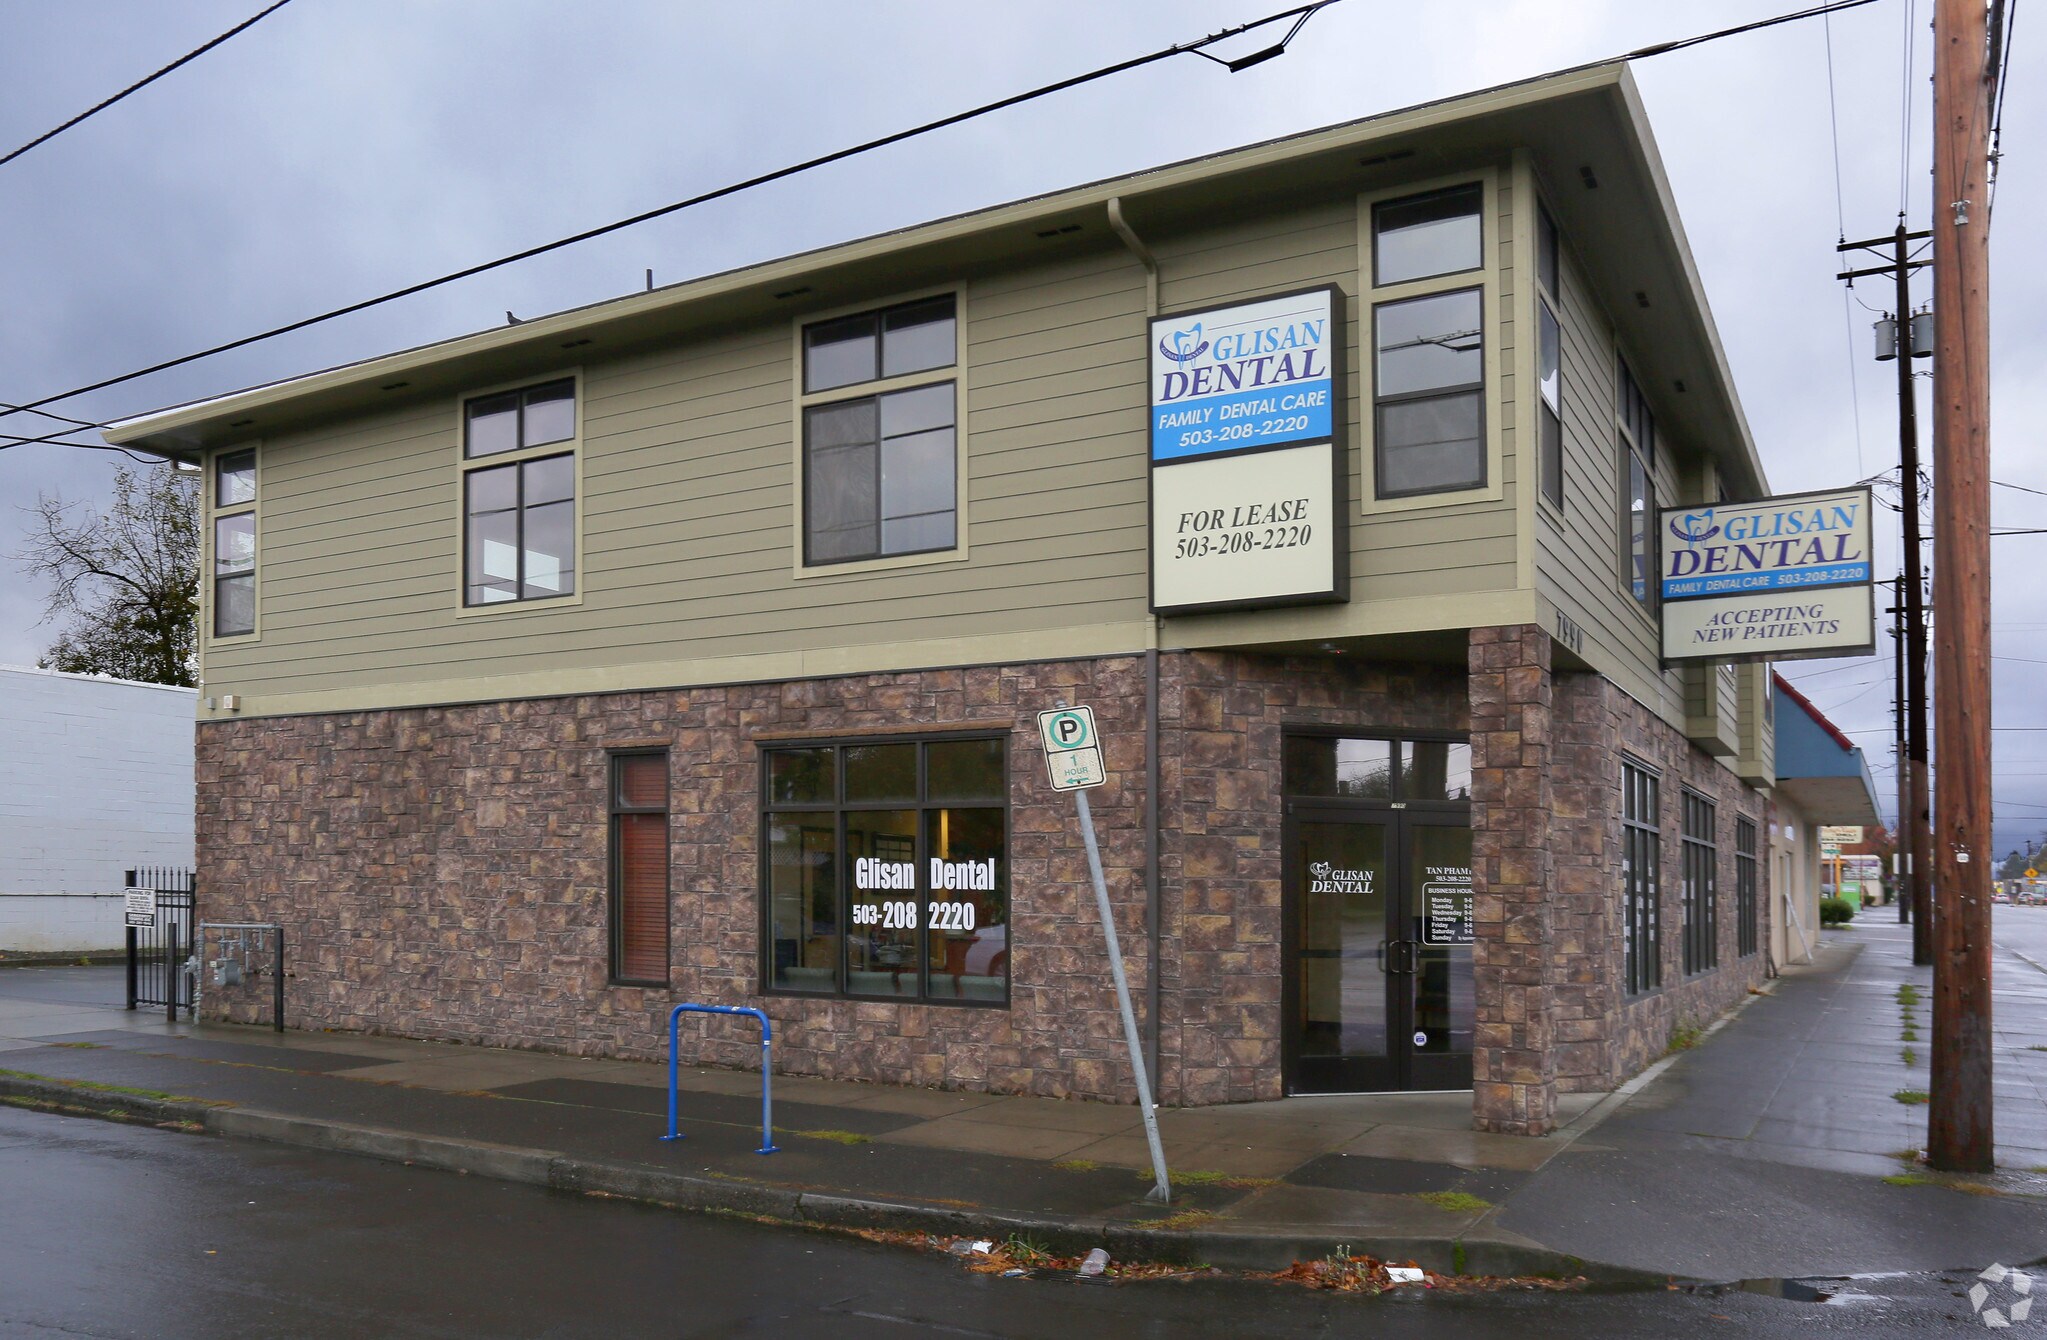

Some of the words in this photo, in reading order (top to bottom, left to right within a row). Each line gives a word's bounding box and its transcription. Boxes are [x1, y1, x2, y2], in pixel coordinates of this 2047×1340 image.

[1213, 319, 1325, 362] GLISAN
[1159, 349, 1326, 401] DENTAL
[1159, 407, 1214, 429] FAMILY
[1219, 397, 1277, 420] DENTAL
[1281, 390, 1326, 411] CARE
[1179, 415, 1309, 446] 503-208-2220
[1177, 508, 1225, 534] FOR
[1231, 498, 1309, 528] LEASE
[1724, 504, 1858, 541] GLISAN
[1175, 524, 1311, 559] 503-208-2220
[1667, 533, 1861, 577] DENTAL
[1669, 581, 1702, 594] FAMILY
[1706, 579, 1743, 591] DENTAL
[1743, 575, 1770, 588] CARE
[1777, 567, 1863, 585] 503-208-2220
[1706, 604, 1824, 626] ACCEPTING
[1692, 627, 1738, 643] NEW
[1742, 620, 1839, 640] PATIENTS
[1059, 720, 1077, 741] P
[1064, 767, 1088, 776] HOUR
[1070, 754, 1077, 766] 1
[855, 857, 915, 889] Glisan
[930, 857, 995, 890] Dental
[1311, 881, 1373, 893] DENTAL
[1332, 870, 1373, 881] GLISAN
[853, 901, 917, 929] 503-208
[928, 902, 975, 930] 2220
